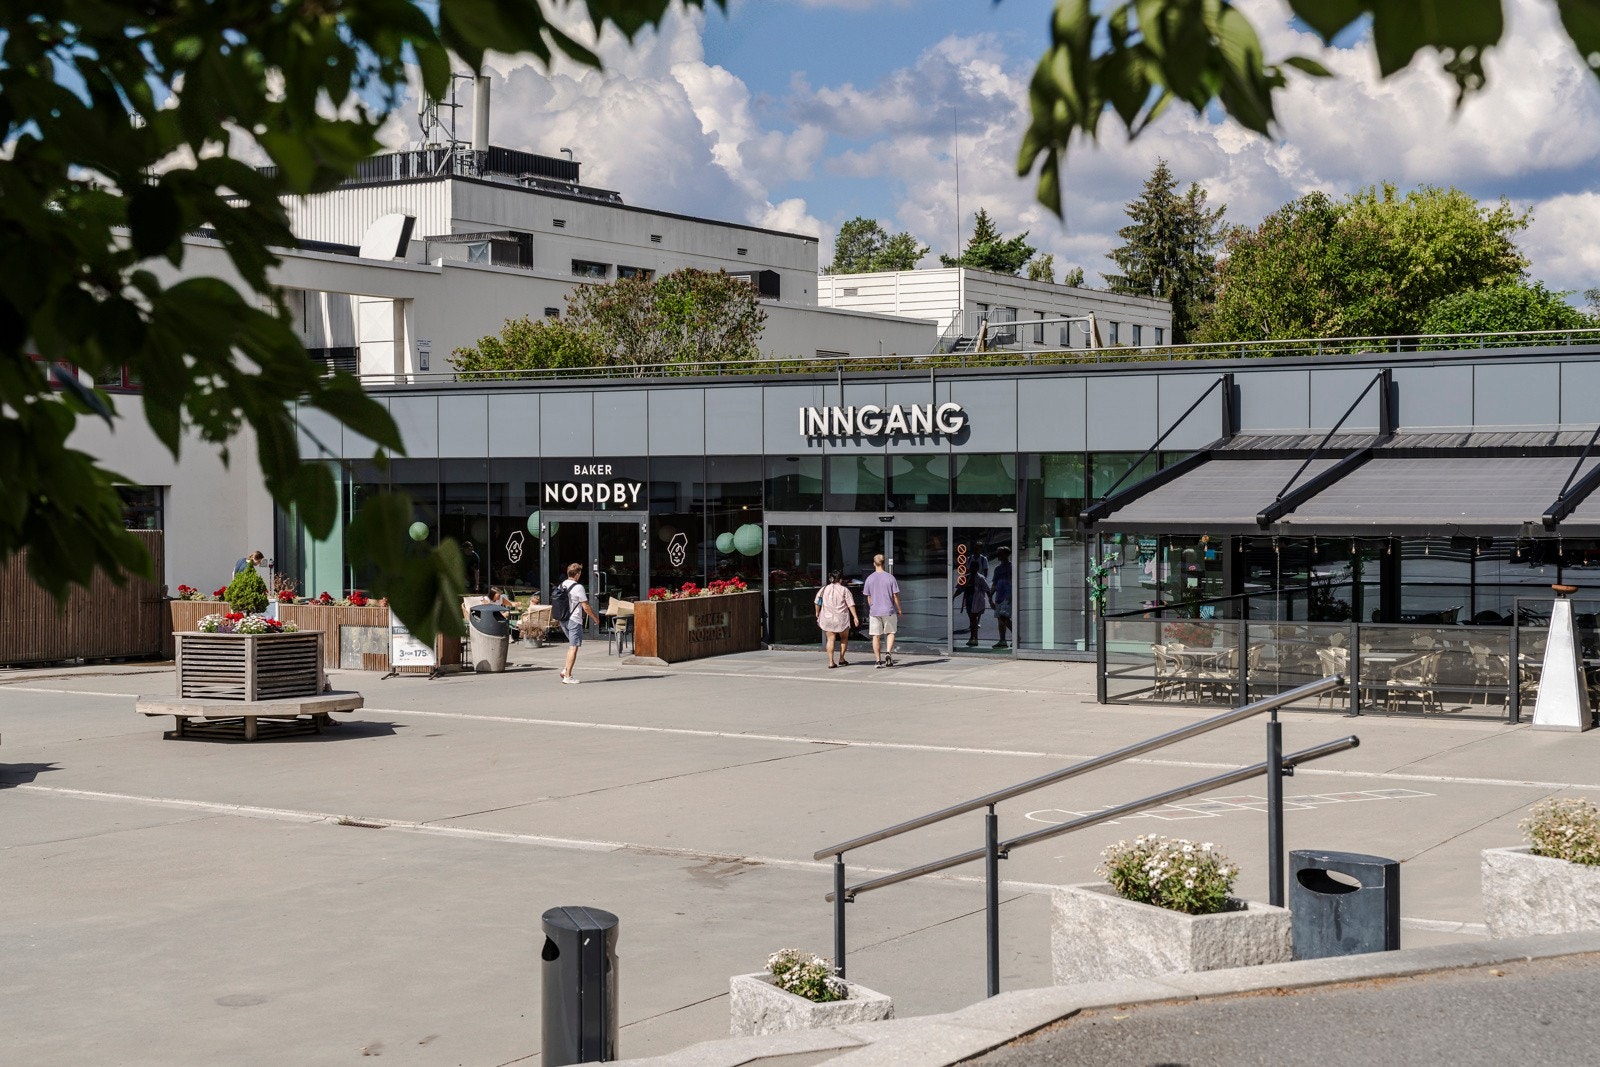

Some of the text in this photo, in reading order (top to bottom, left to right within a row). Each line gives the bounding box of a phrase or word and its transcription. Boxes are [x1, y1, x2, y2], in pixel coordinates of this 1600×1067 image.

[799, 402, 964, 436] INNGANG
[574, 464, 612, 475] BAKER
[545, 483, 641, 503] NORDBY
